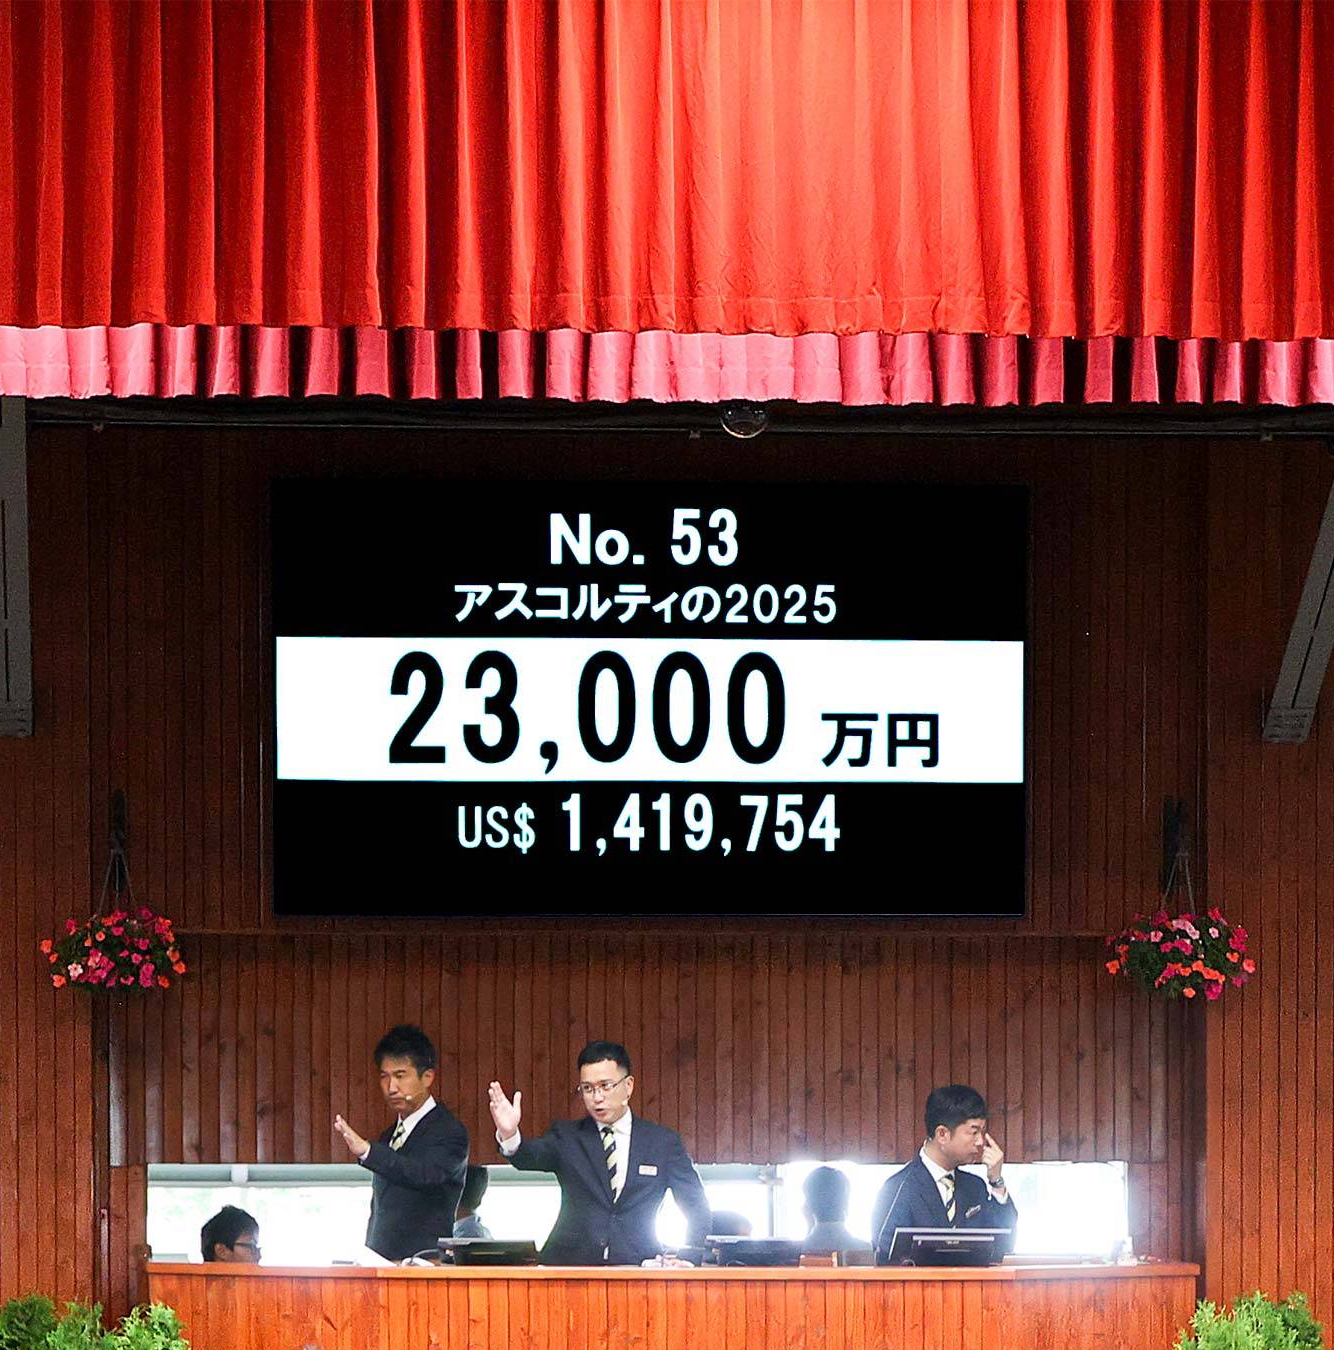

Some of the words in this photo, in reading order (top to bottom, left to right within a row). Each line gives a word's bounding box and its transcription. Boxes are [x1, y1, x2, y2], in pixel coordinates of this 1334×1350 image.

[549, 512, 645, 566] No.
[670, 508, 739, 567] 53
[453, 582, 838, 625] アスコルティの2025
[388, 650, 786, 775] 23,000
[820, 712, 940, 768] 万円
[457, 802, 536, 855] US$
[561, 792, 841, 857] 1,419,754
